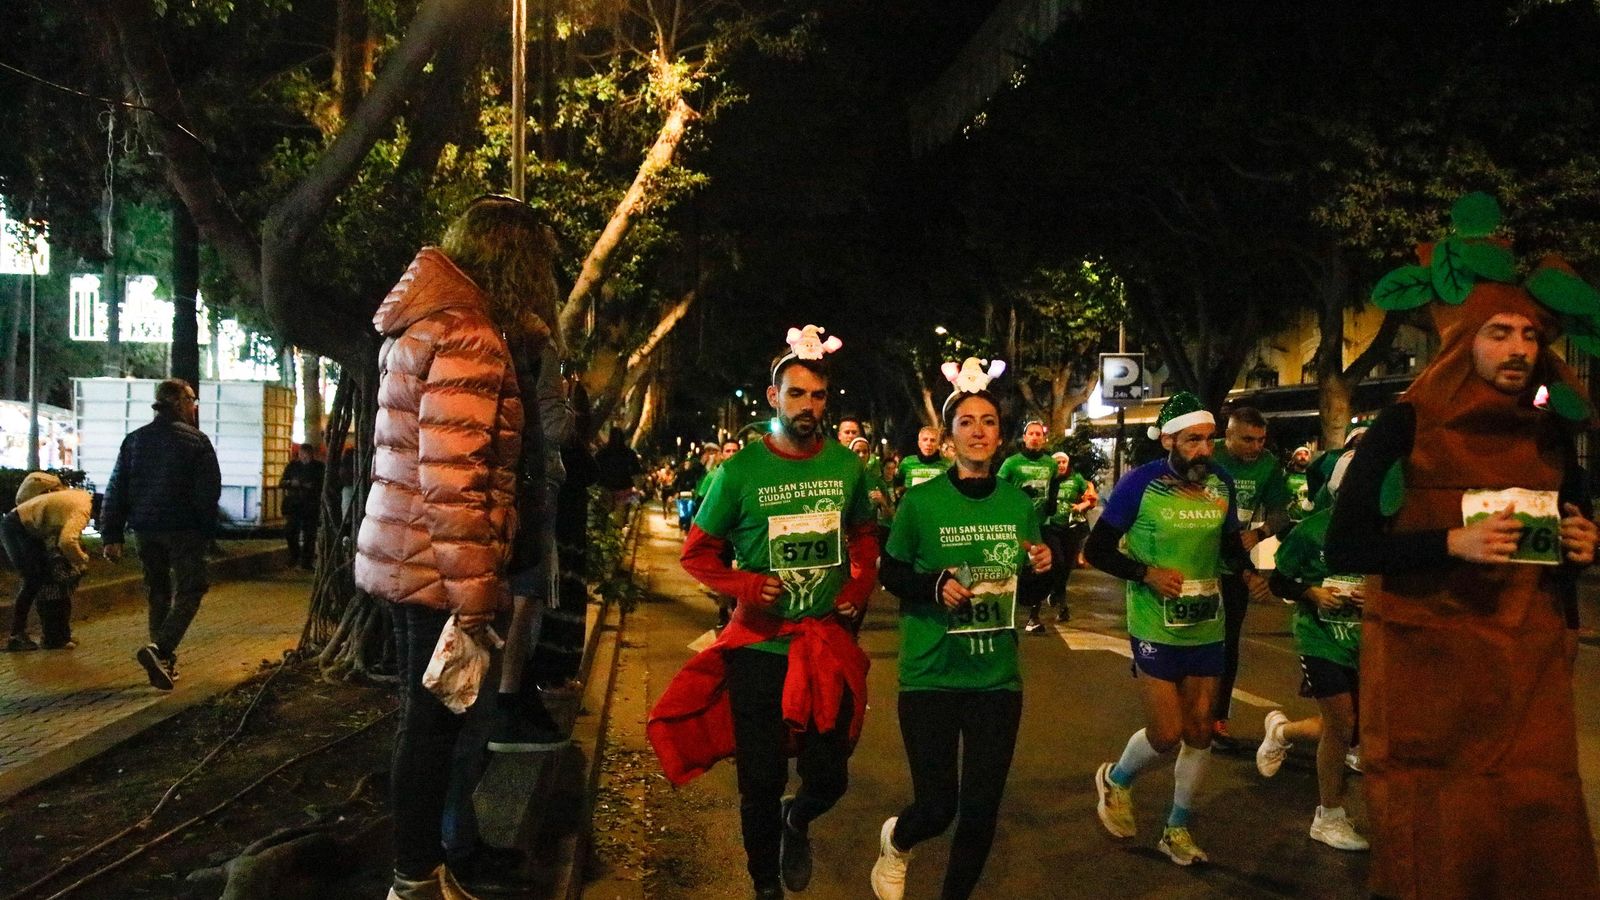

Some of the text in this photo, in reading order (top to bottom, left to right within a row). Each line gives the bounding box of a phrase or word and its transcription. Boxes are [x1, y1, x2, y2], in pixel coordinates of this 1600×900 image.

[1103, 357, 1140, 398] P
[758, 480, 844, 495] XVII SAN SILVESTRE
[758, 492, 792, 503] CIUDAD
[794, 490, 806, 498] DE
[808, 487, 844, 497] ALMERÍA
[1179, 510, 1222, 519] SAKATA
[939, 524, 1017, 535] XVII SAN SILVESTRE
[940, 531, 1017, 543] CIUDAD DE ALMERÍA
[783, 540, 829, 561] 579
